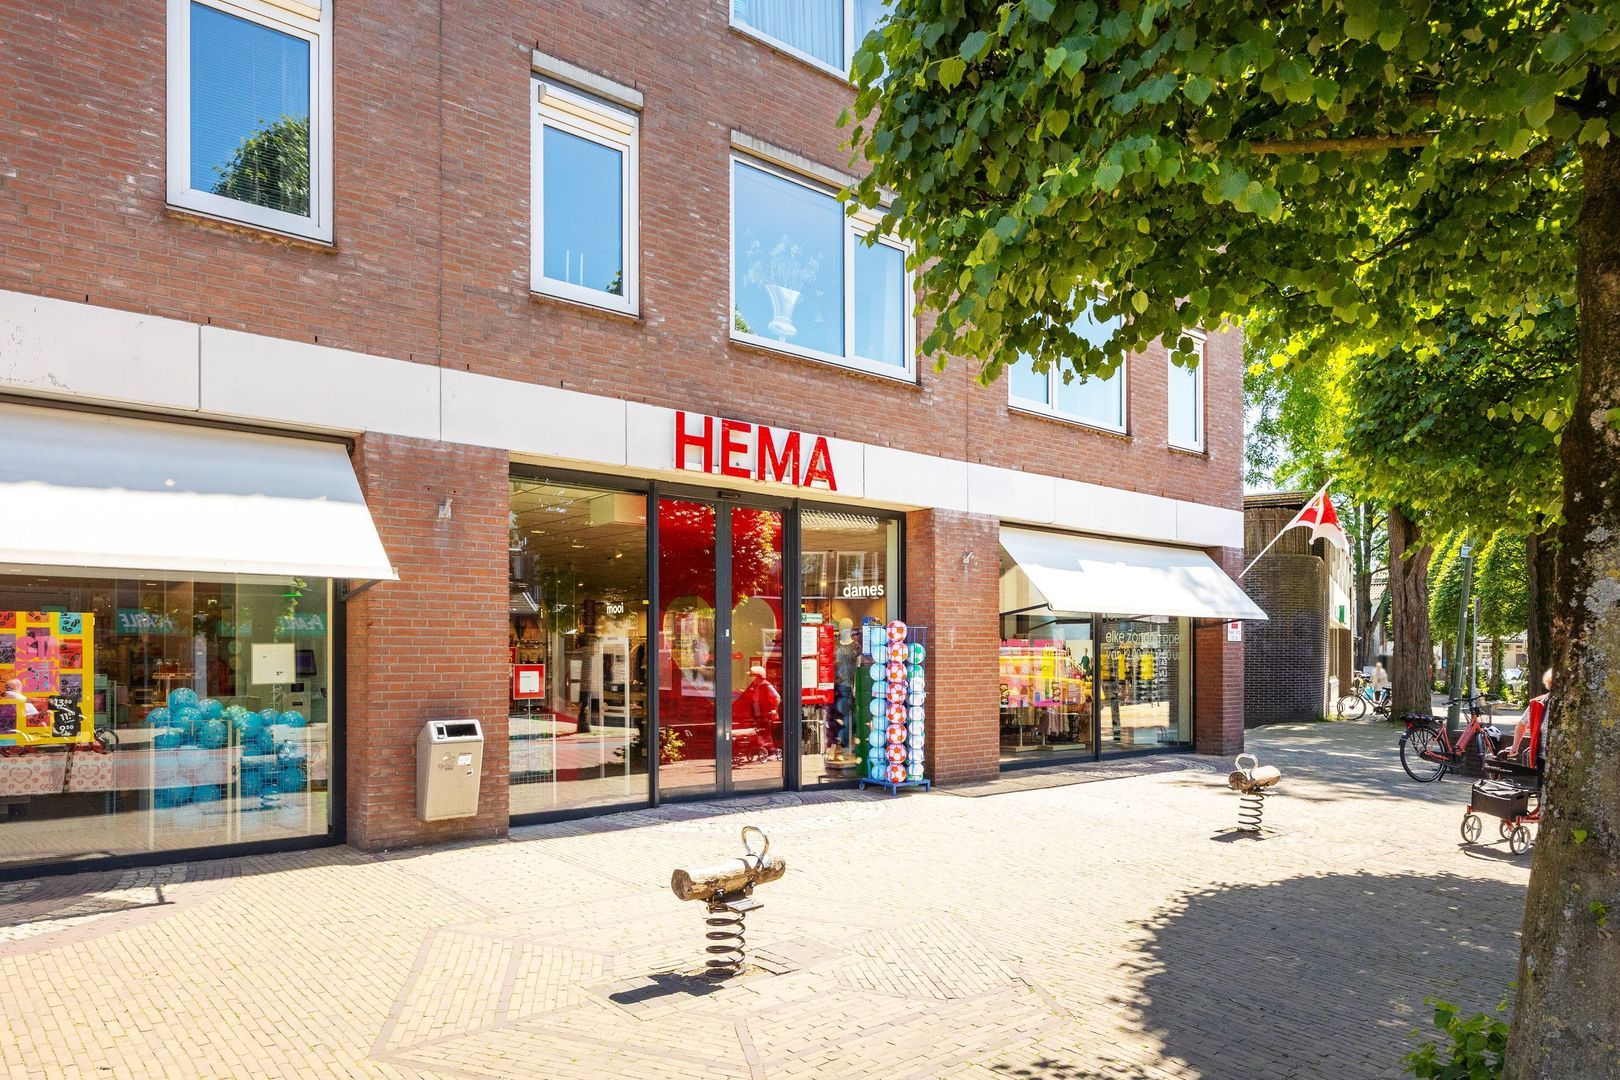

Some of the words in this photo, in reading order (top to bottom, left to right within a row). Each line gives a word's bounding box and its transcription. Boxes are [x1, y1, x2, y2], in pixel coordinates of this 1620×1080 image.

[675, 410, 838, 491] HEMA
[843, 583, 884, 598] dames
[606, 602, 624, 615] mooi
[1105, 630, 1125, 643] elke
[16, 635, 60, 660] STA
